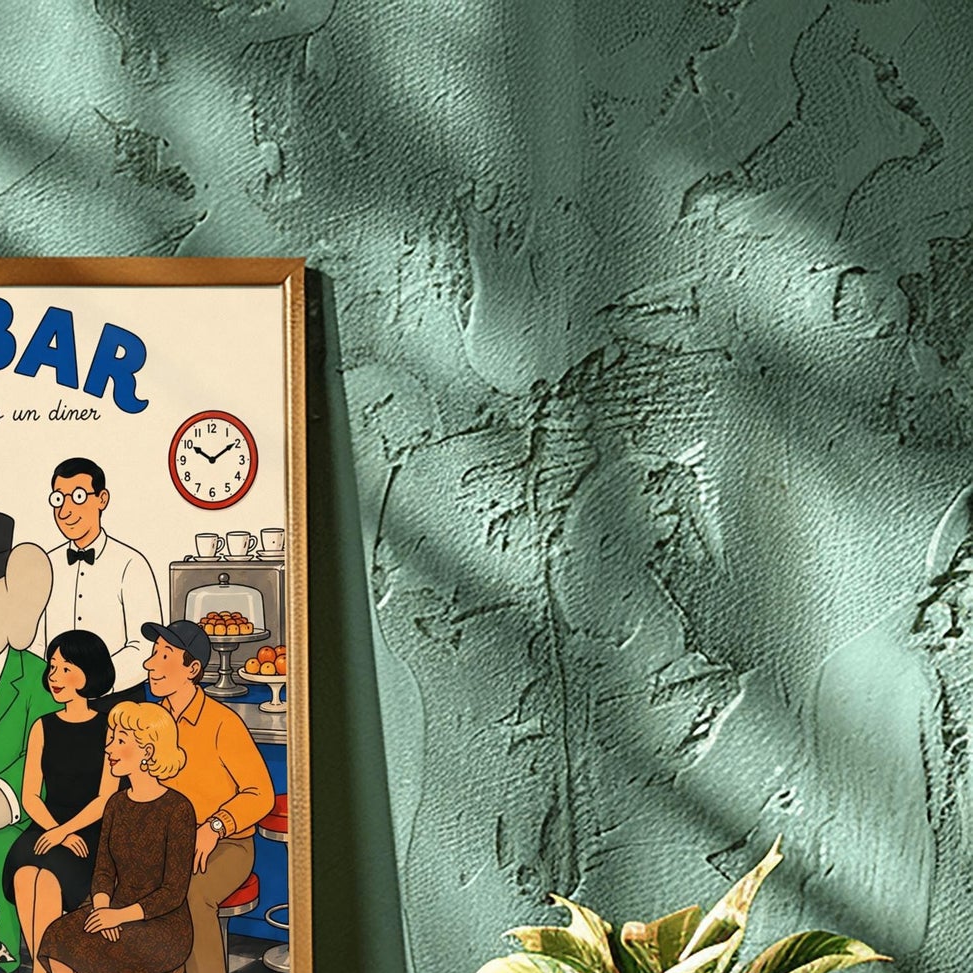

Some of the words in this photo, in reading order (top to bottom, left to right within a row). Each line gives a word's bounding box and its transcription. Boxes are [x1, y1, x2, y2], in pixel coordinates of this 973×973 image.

[12, 409, 41, 423] un
[48, 400, 102, 423] diner
[207, 423, 217, 433] 12
[184, 439, 193, 449] 10
[234, 438, 241, 448] 2
[180, 455, 187, 465] 9
[239, 455, 245, 465] 3
[184, 471, 191, 481] 8
[235, 471, 241, 481] 4
[195, 483, 201, 493] 7
[209, 487, 216, 497] 6
[225, 483, 231, 492] 5
